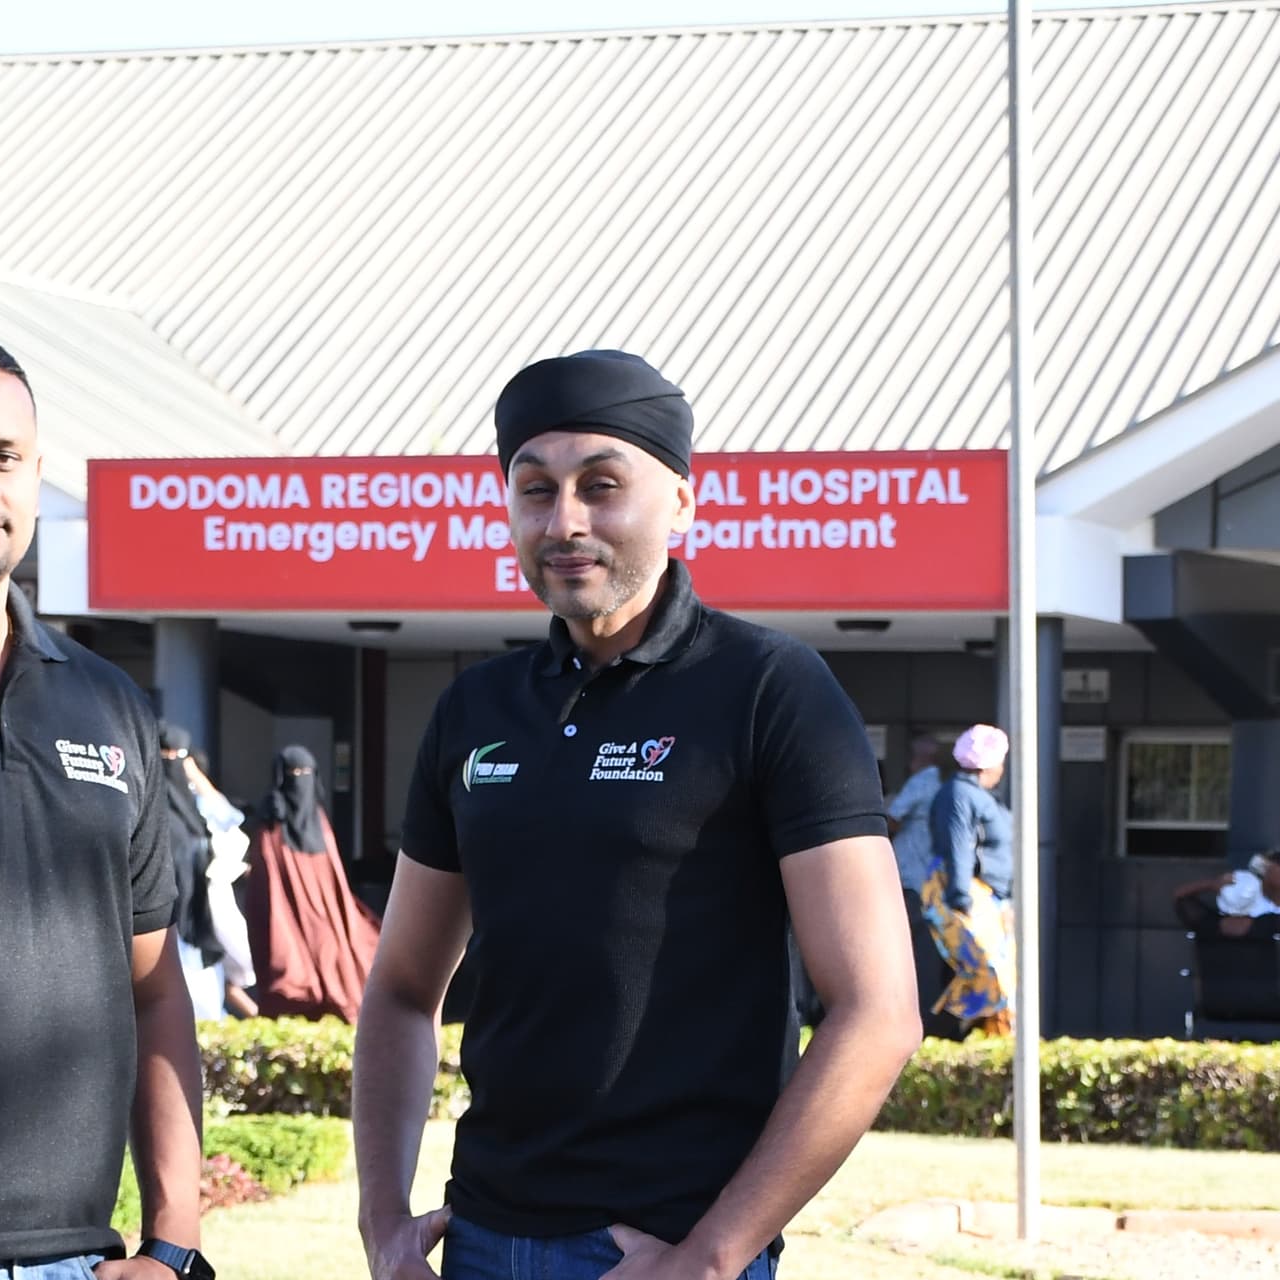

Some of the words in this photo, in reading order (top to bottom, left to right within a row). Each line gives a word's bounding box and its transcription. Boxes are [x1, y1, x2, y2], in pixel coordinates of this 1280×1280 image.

[129, 474, 310, 509] DODOMA
[321, 473, 510, 507] REGIONA
[759, 468, 969, 505] HOSPITAL
[204, 515, 436, 562] Emergency
[599, 742, 626, 755] Give
[627, 742, 637, 754] A
[593, 756, 636, 767] Future
[589, 767, 663, 781] Foundation
